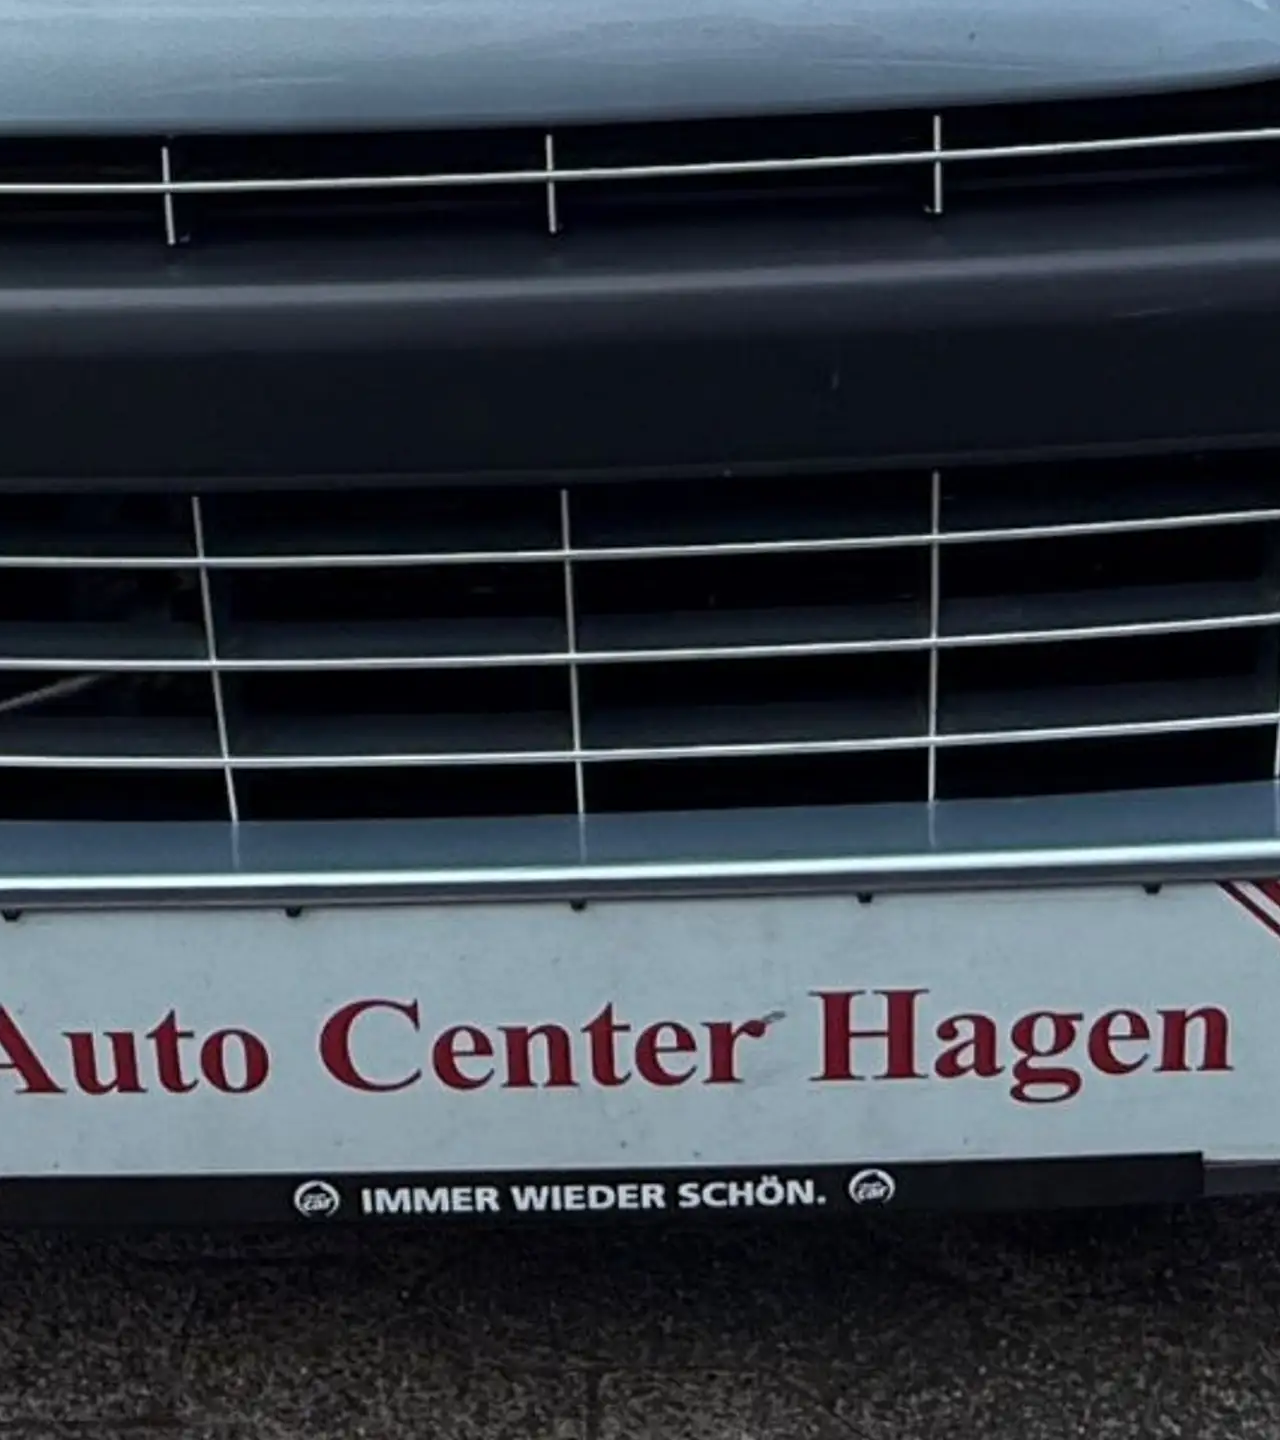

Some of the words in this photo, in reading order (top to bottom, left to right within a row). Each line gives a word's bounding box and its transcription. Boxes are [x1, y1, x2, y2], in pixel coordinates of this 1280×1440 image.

[318, 999, 766, 1092] Center
[810, 988, 1234, 1105] Hagen
[360, 1186, 500, 1214] IMMER
[510, 1183, 666, 1211] WIEDER
[677, 1174, 827, 1208] SCHÖN.
